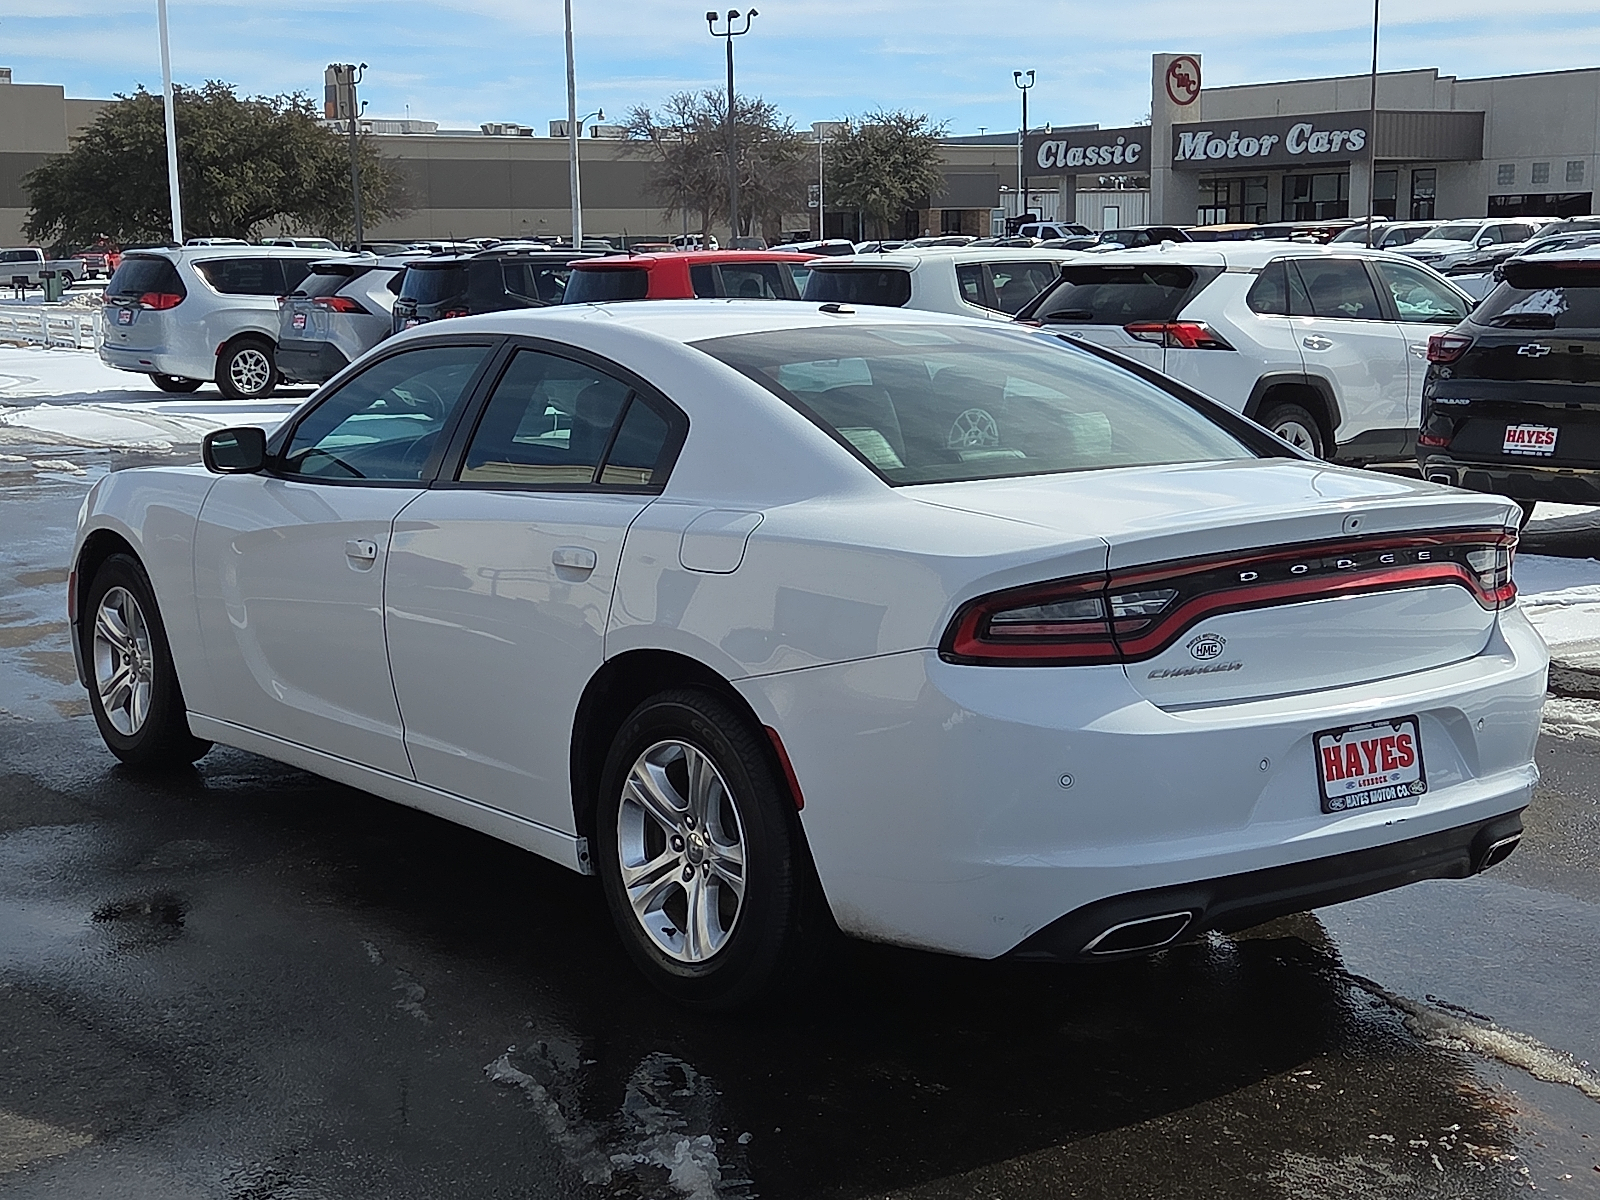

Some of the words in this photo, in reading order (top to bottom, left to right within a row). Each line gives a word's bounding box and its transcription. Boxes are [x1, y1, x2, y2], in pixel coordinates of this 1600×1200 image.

[1037, 136, 1142, 169] Classic
[1174, 131, 1279, 161] Motor
[1286, 123, 1366, 154] Cars
[1506, 430, 1555, 445] HAYES
[1239, 551, 1431, 582] DODGE
[1196, 643, 1217, 656] HMC
[1148, 661, 1243, 679] CHARGER
[1323, 734, 1415, 782] HAYES
[1345, 792, 1369, 808] HAYES
[1370, 788, 1397, 803] MOTOR
